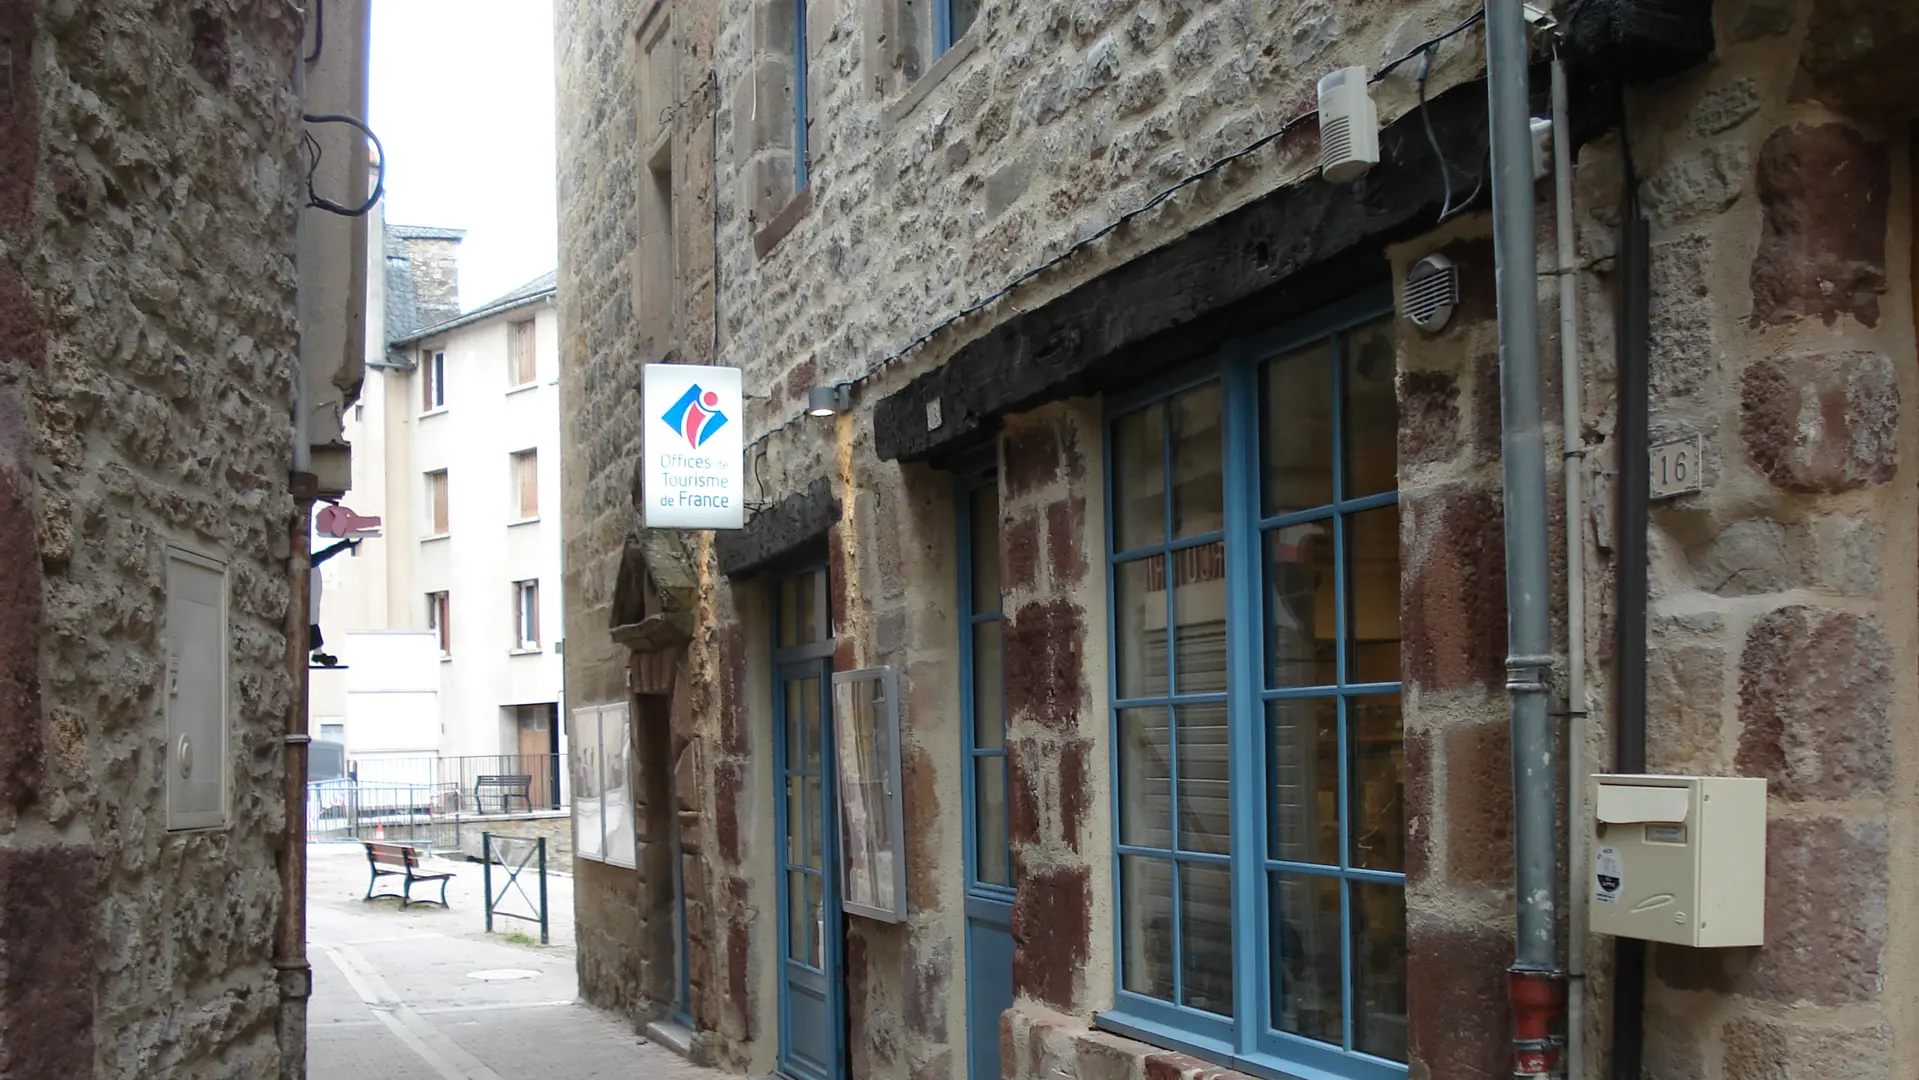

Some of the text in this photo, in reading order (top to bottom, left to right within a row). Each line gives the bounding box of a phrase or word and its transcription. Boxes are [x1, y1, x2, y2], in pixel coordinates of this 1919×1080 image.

[660, 453, 711, 469] Offices
[1661, 451, 1687, 485] 16
[661, 472, 729, 488] Tourisme
[660, 490, 729, 508] de France
